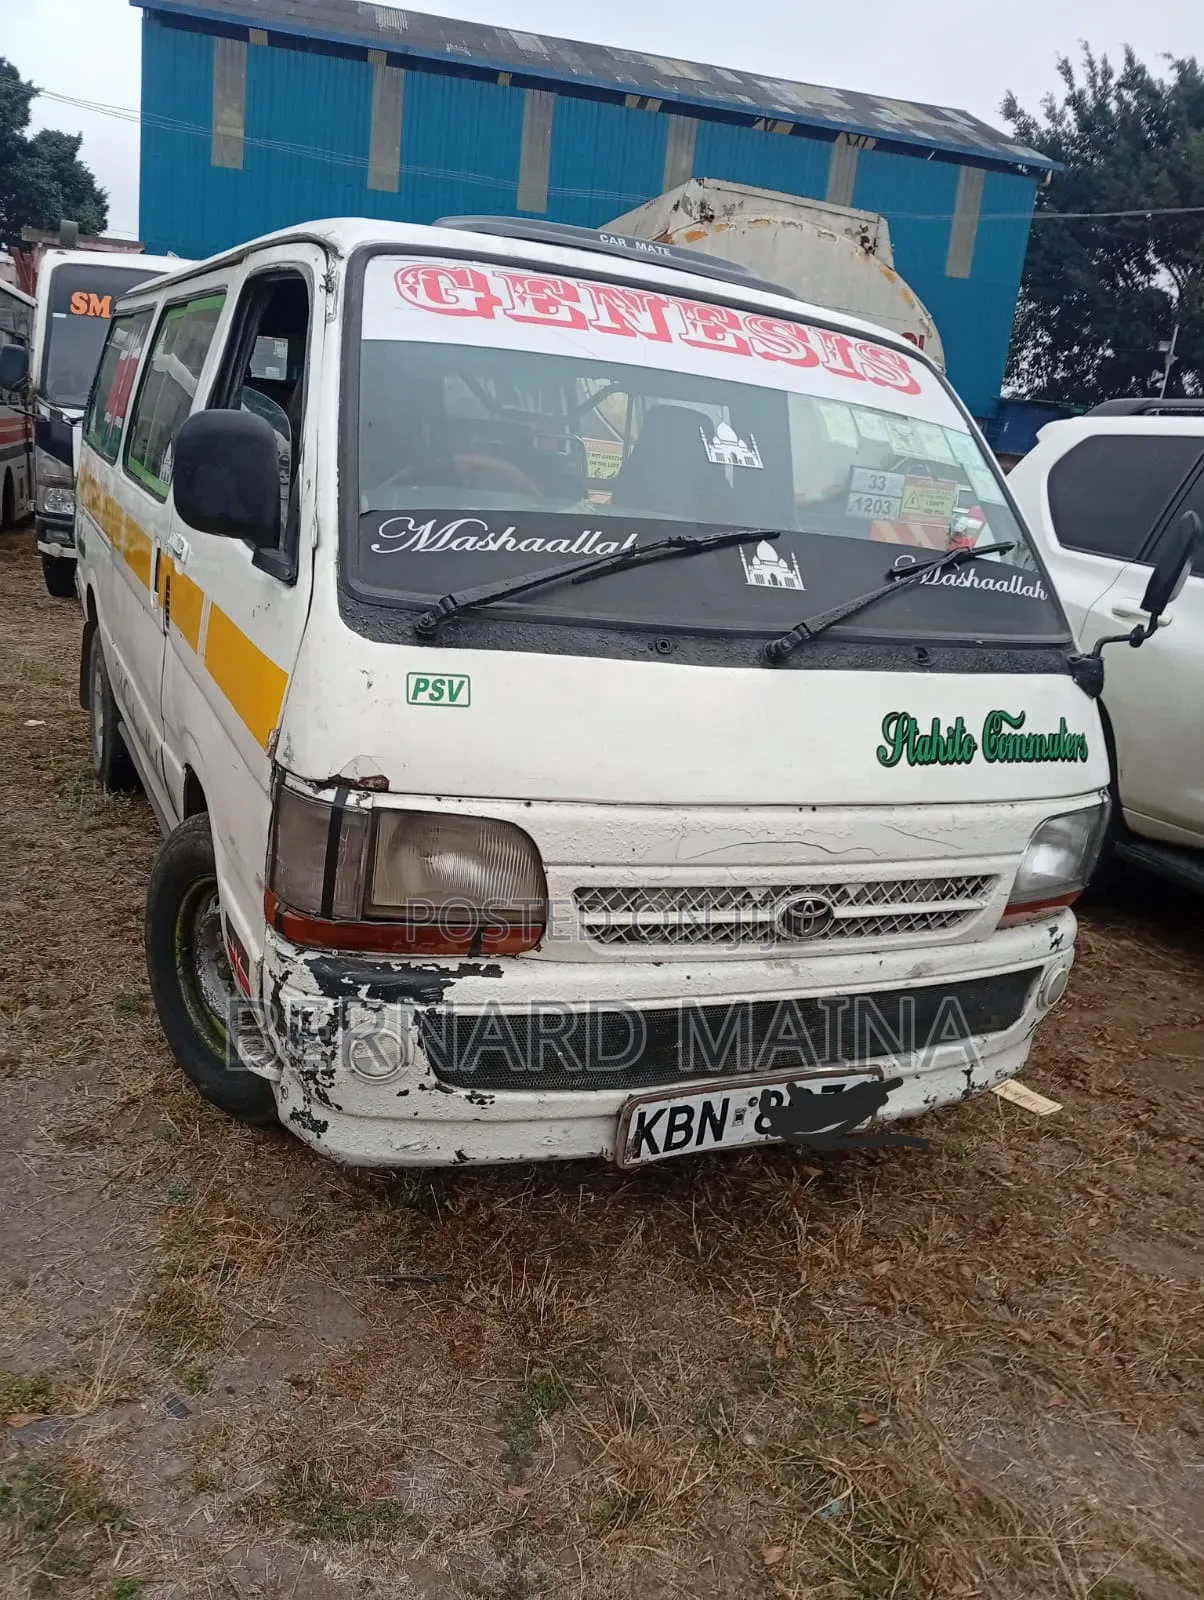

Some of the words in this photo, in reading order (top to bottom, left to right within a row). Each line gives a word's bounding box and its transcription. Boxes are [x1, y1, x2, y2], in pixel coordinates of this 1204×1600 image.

[600, 234, 627, 247] CAR
[635, 241, 672, 256] MATE
[394, 264, 921, 395] GENESIS
[868, 474, 886, 491] 33
[855, 496, 892, 515] 1203
[412, 678, 465, 702] PSV
[982, 710, 1088, 763] Commuters
[631, 1098, 731, 1160] KBN
